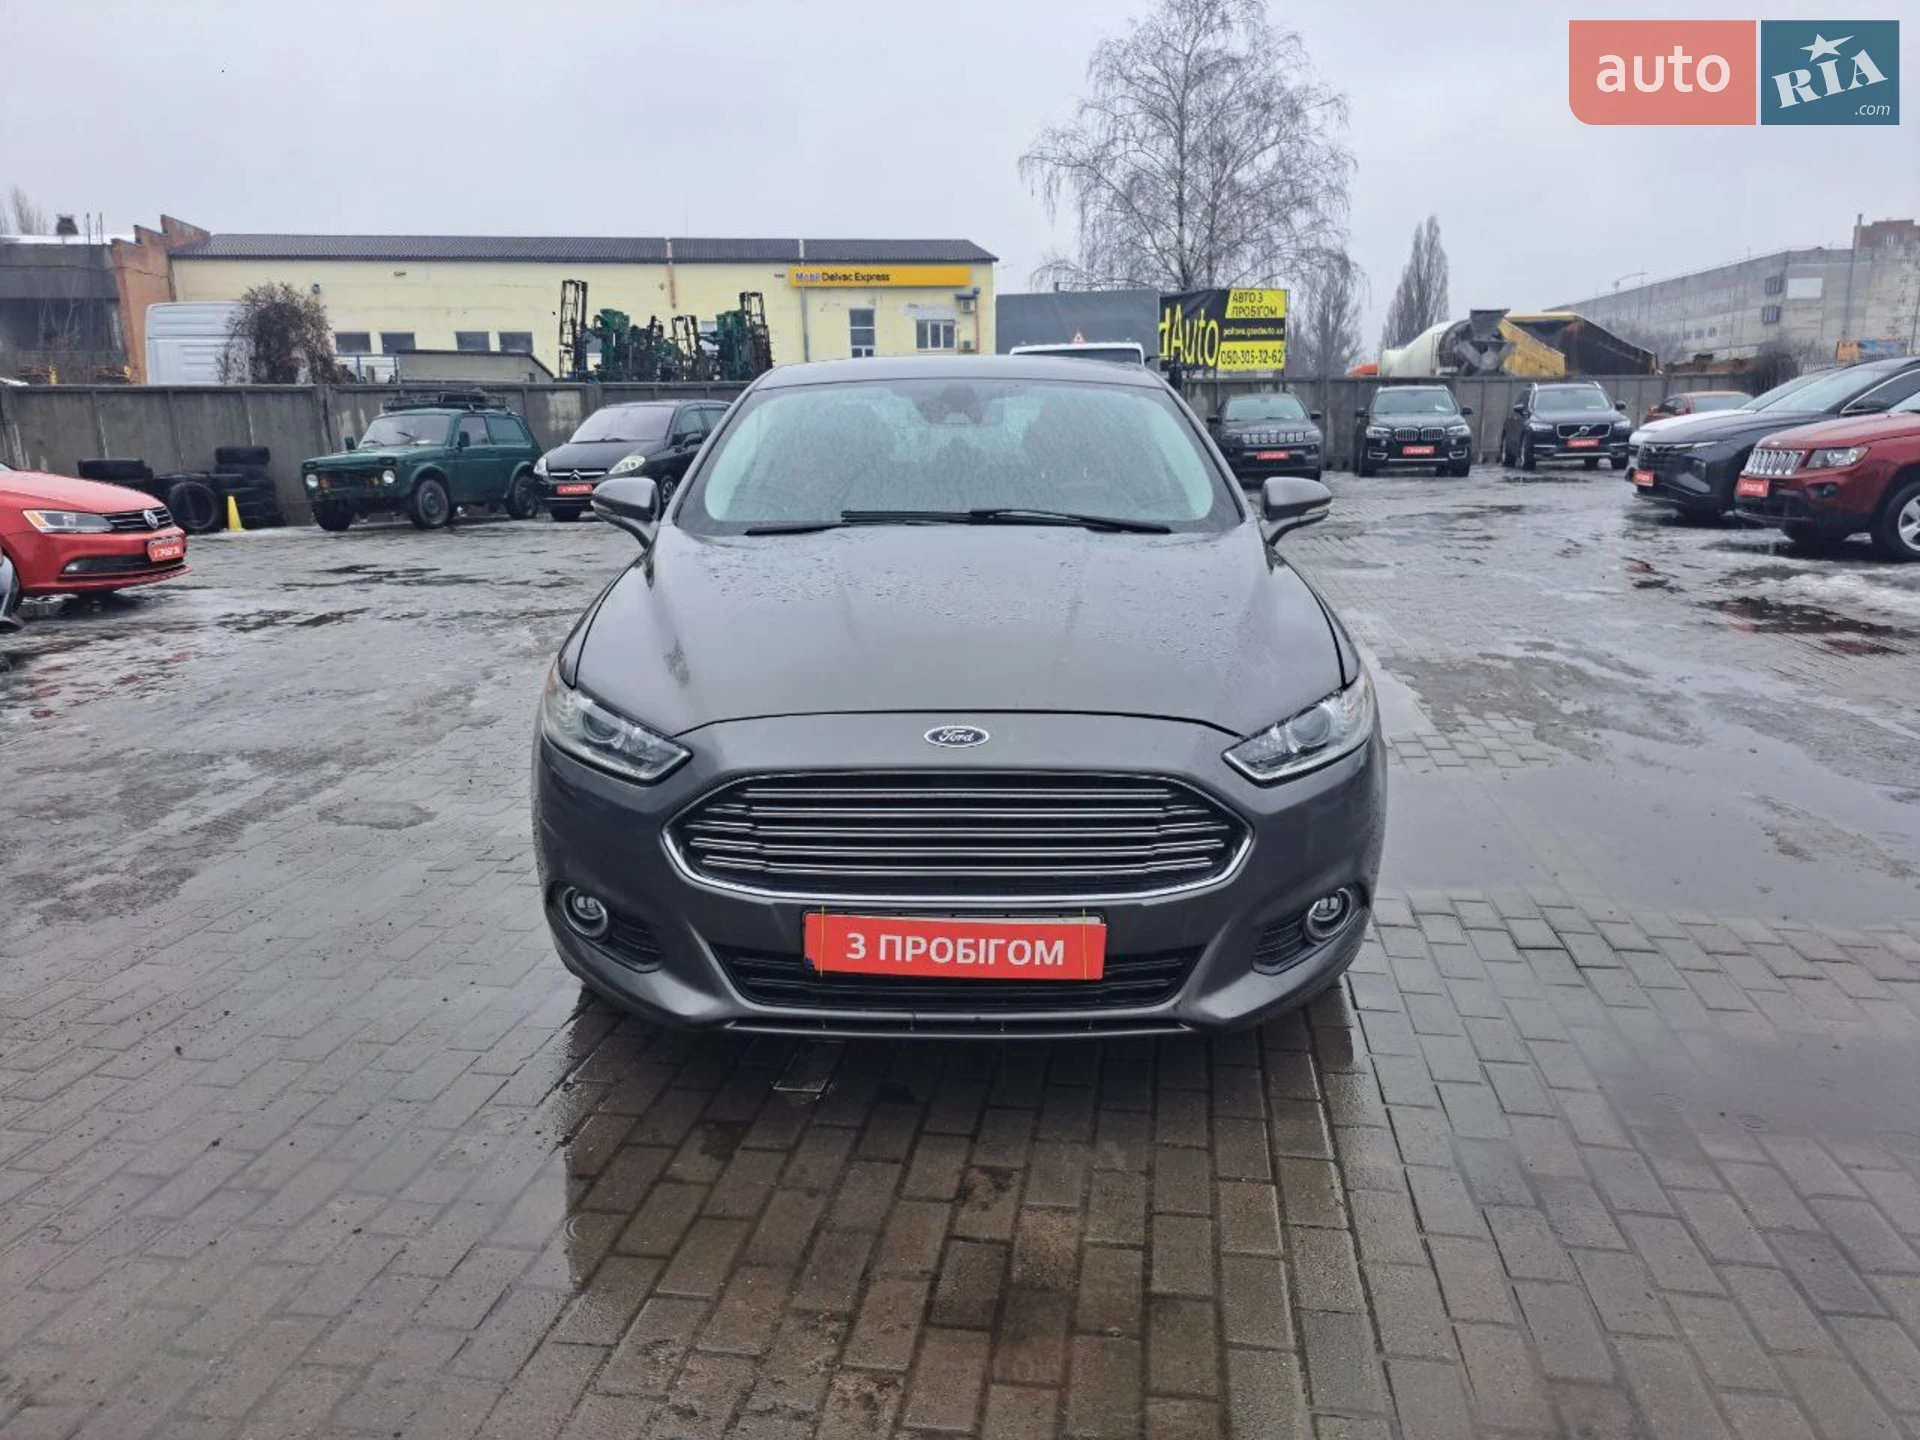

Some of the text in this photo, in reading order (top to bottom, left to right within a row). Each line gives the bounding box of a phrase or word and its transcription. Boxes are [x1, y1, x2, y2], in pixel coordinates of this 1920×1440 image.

[821, 272, 853, 282] Delvac
[854, 272, 890, 283] Express
[1232, 292, 1256, 304] АВТО
[1232, 305, 1278, 317] ПРОБІГОМ
[1220, 349, 1283, 364] 050-305-32-62
[938, 729, 974, 742] Ford
[878, 933, 1065, 966] ПРОБІГОМ
